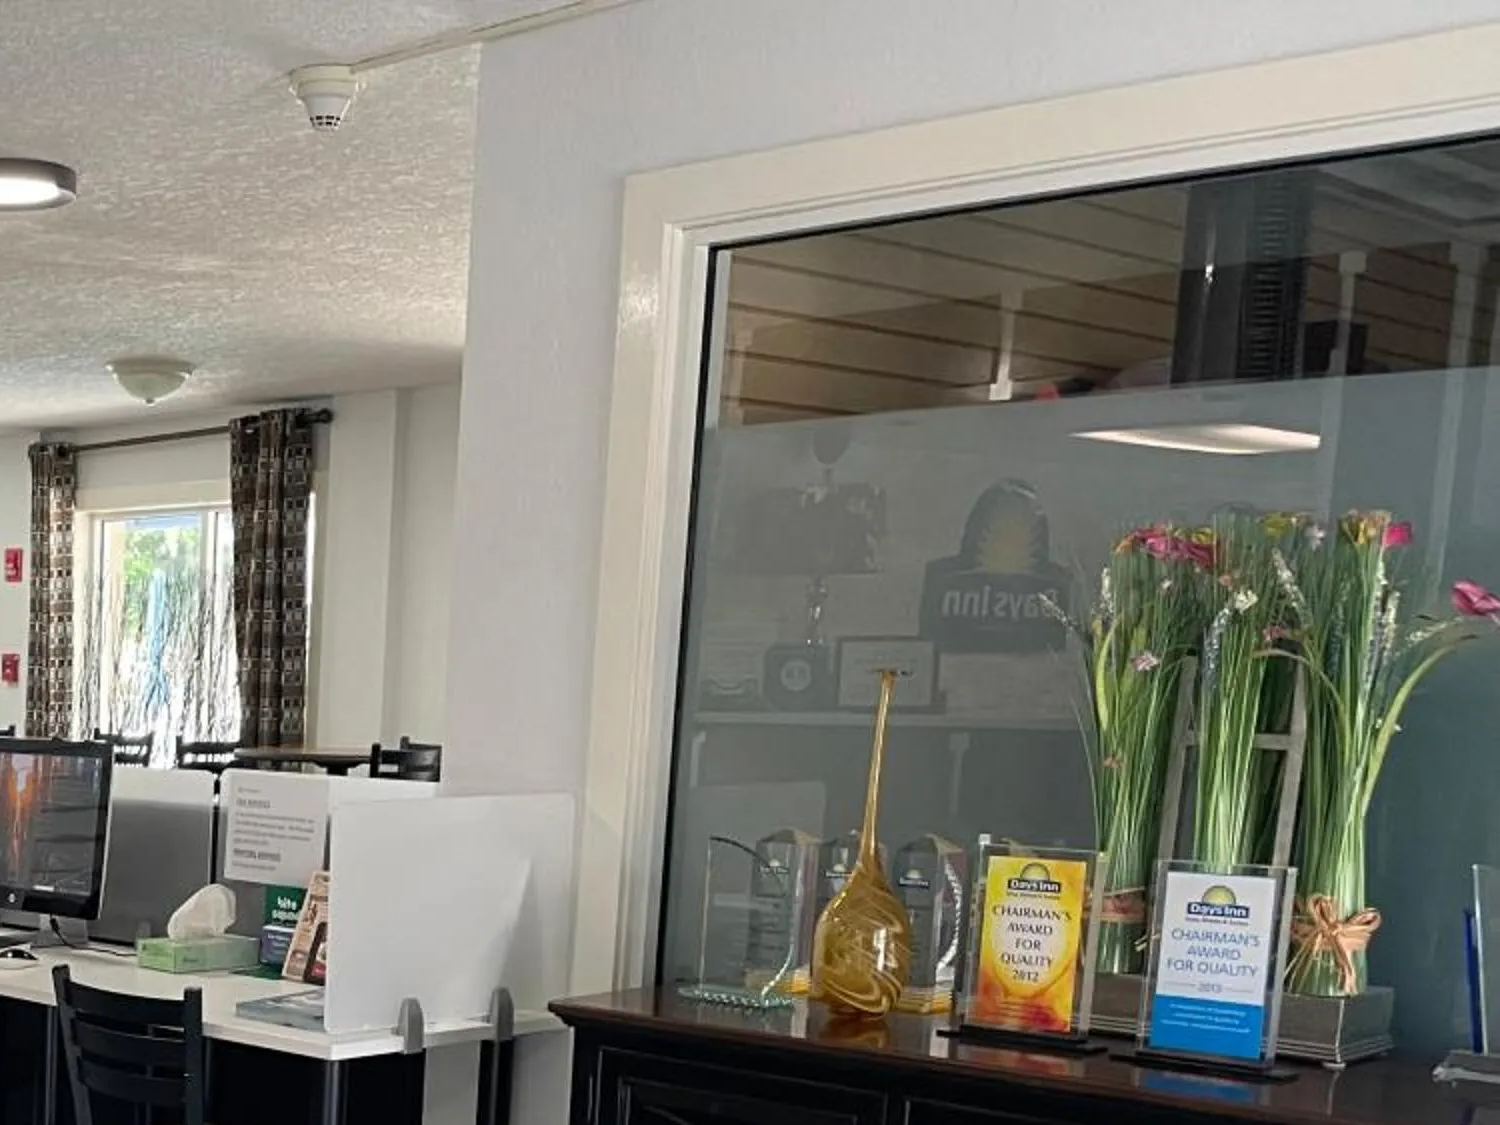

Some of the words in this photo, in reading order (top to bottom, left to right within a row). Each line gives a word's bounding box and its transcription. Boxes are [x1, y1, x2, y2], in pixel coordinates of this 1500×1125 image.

[1039, 881, 1060, 892] Inn
[992, 904, 1073, 921] CHAIRMAN'S
[1190, 903, 1222, 916] Days
[1224, 906, 1247, 917] Inn
[1007, 923, 1053, 936] AWARD
[1171, 927, 1261, 947] CHAIRMAN'S
[1015, 938, 1042, 951] FOR
[1000, 952, 1054, 968] QUALITY
[1187, 945, 1242, 961] AWARD
[1167, 957, 1193, 972] FOR
[1197, 961, 1260, 977] QUALITY
